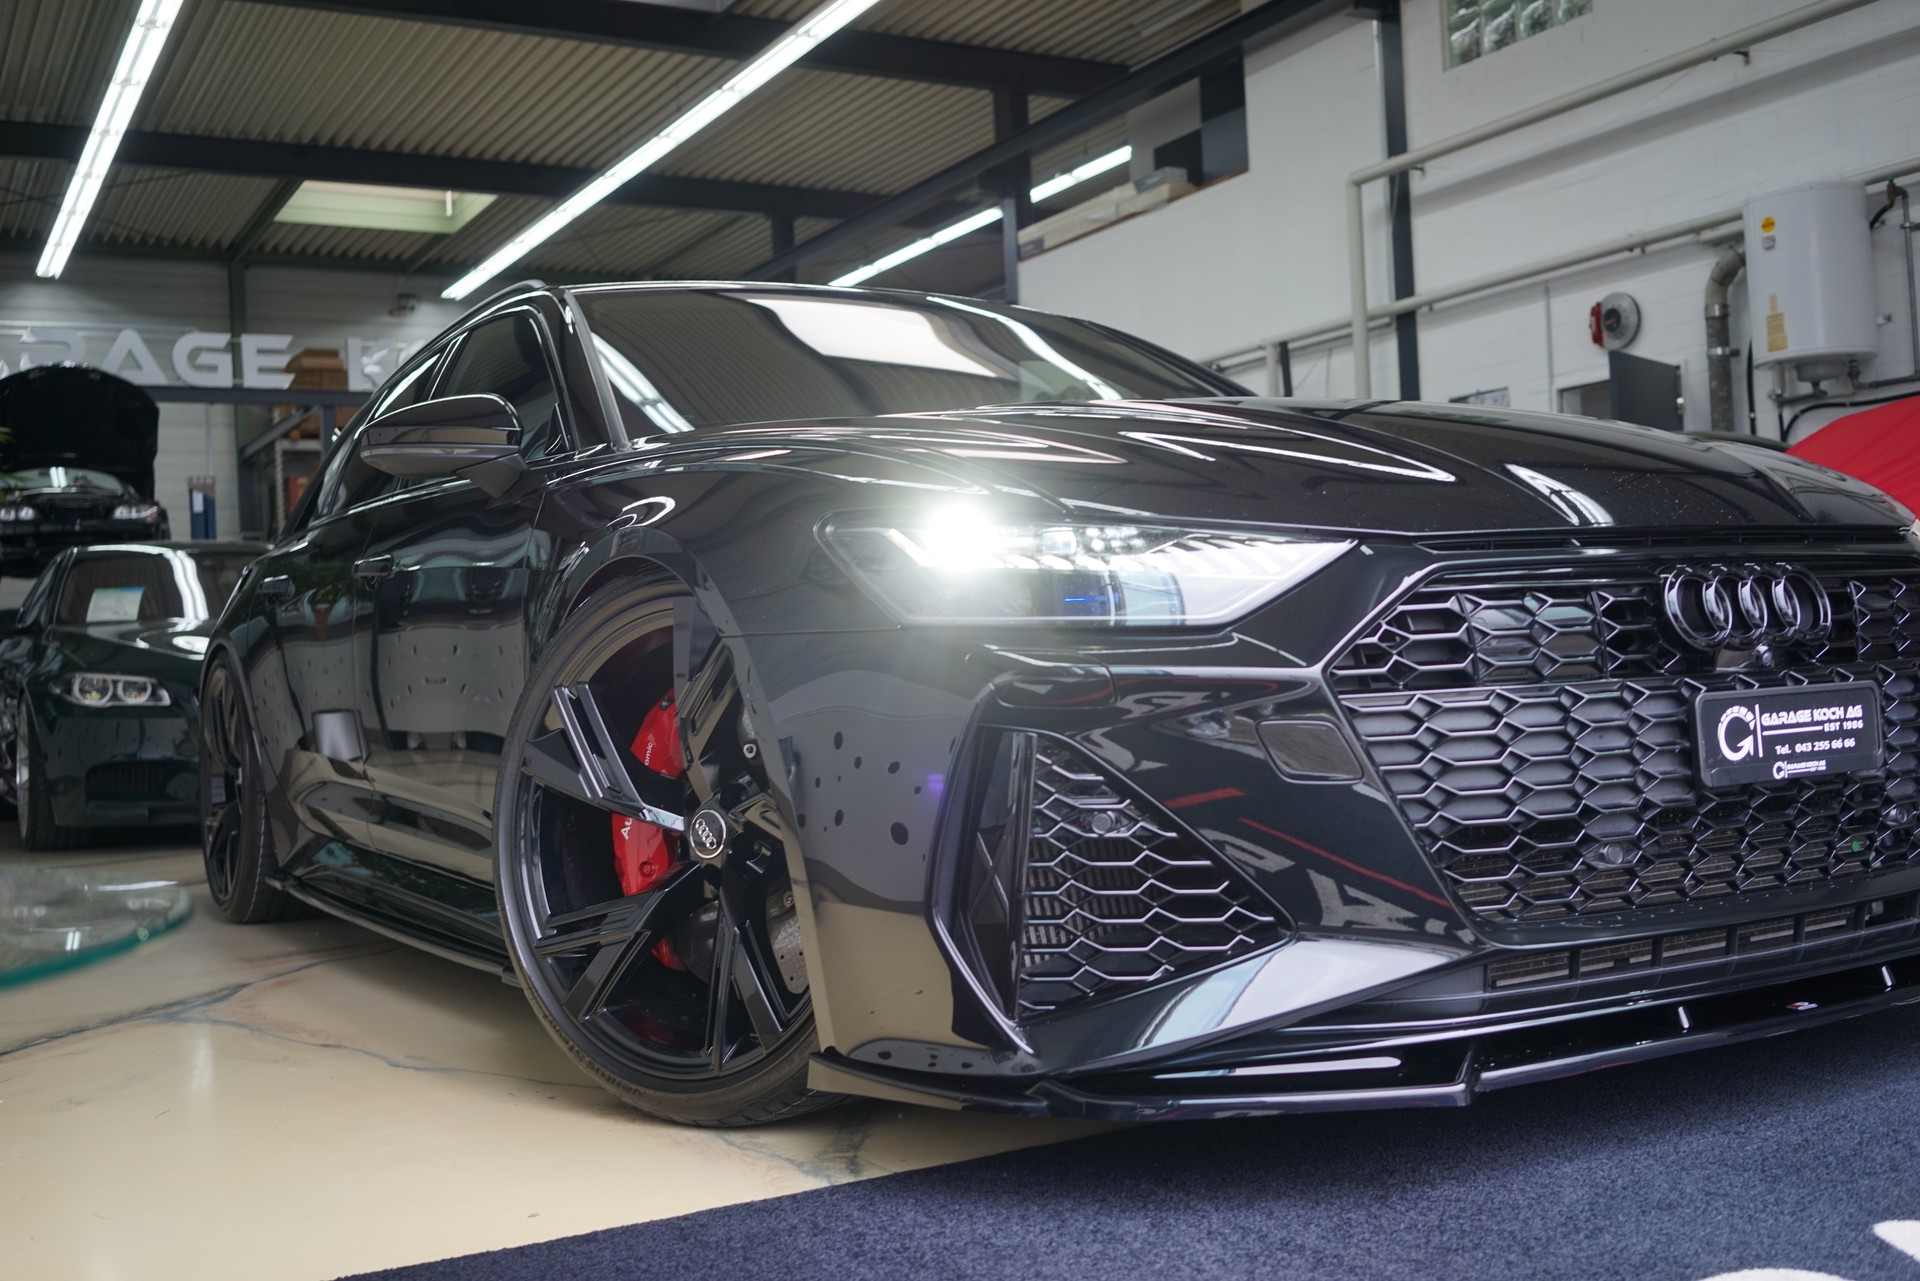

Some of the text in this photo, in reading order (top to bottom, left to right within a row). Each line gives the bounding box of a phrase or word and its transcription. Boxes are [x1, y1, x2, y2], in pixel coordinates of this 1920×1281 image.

[0, 326, 426, 393] RAGE K
[1761, 704, 1863, 726] GARAGE KOCH AG
[1823, 719, 1864, 732] EST 1986
[1774, 737, 1856, 755] Tel. 043 255 66 66
